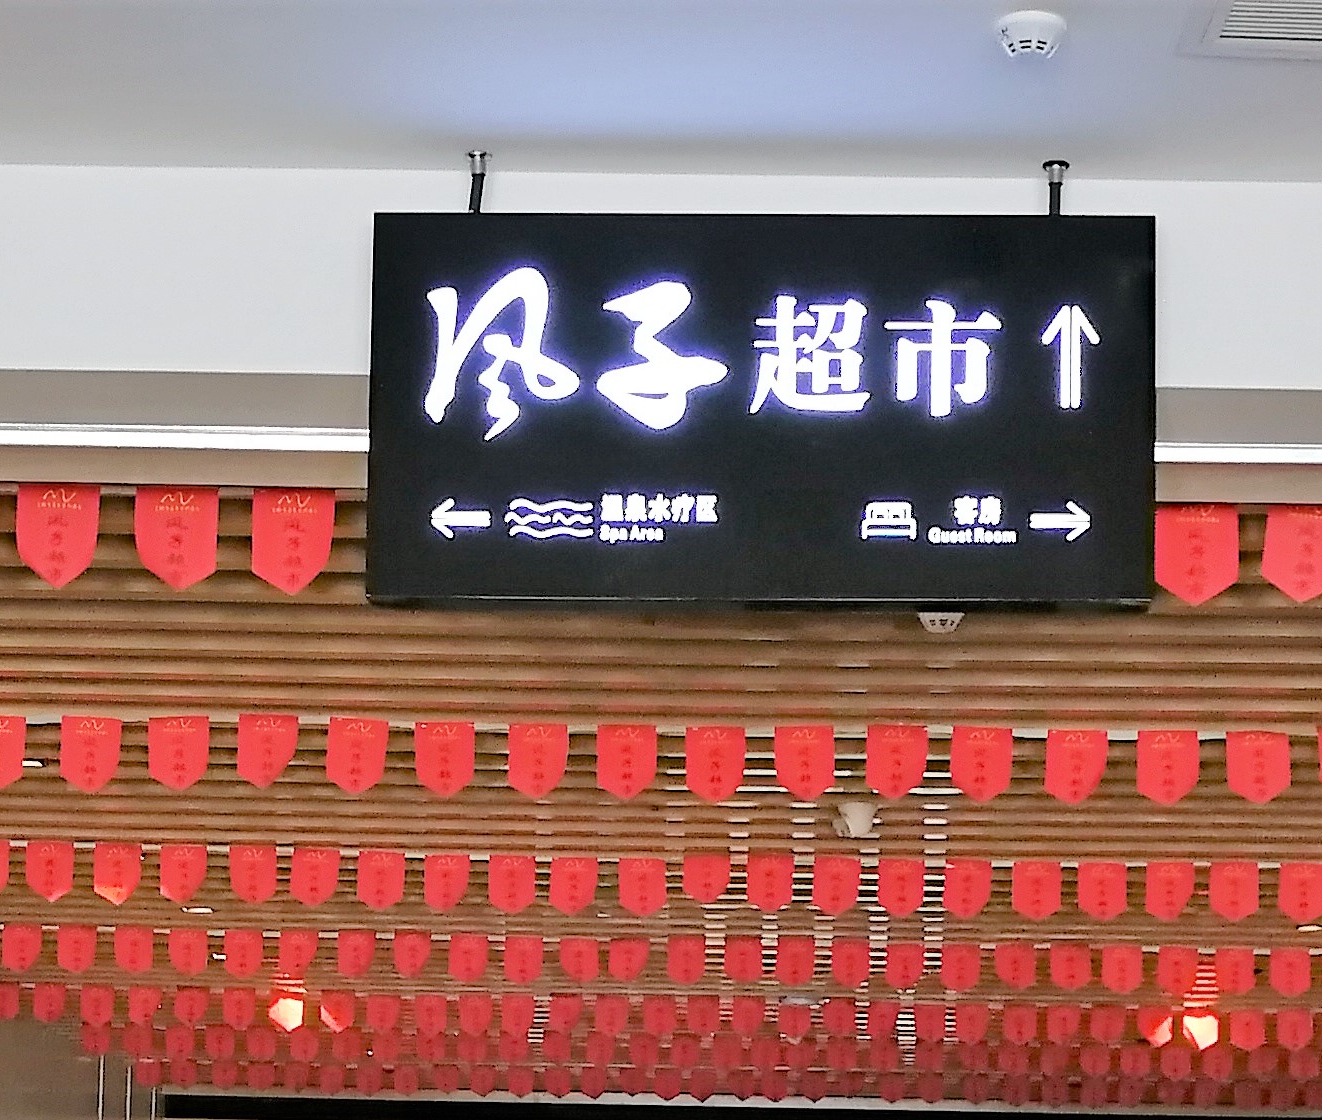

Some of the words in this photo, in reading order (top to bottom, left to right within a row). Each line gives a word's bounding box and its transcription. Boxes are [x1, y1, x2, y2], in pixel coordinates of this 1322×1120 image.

[425, 266, 1002, 441] 风子超市
[927, 527, 973, 544] Guest
[973, 527, 1018, 544] Room
